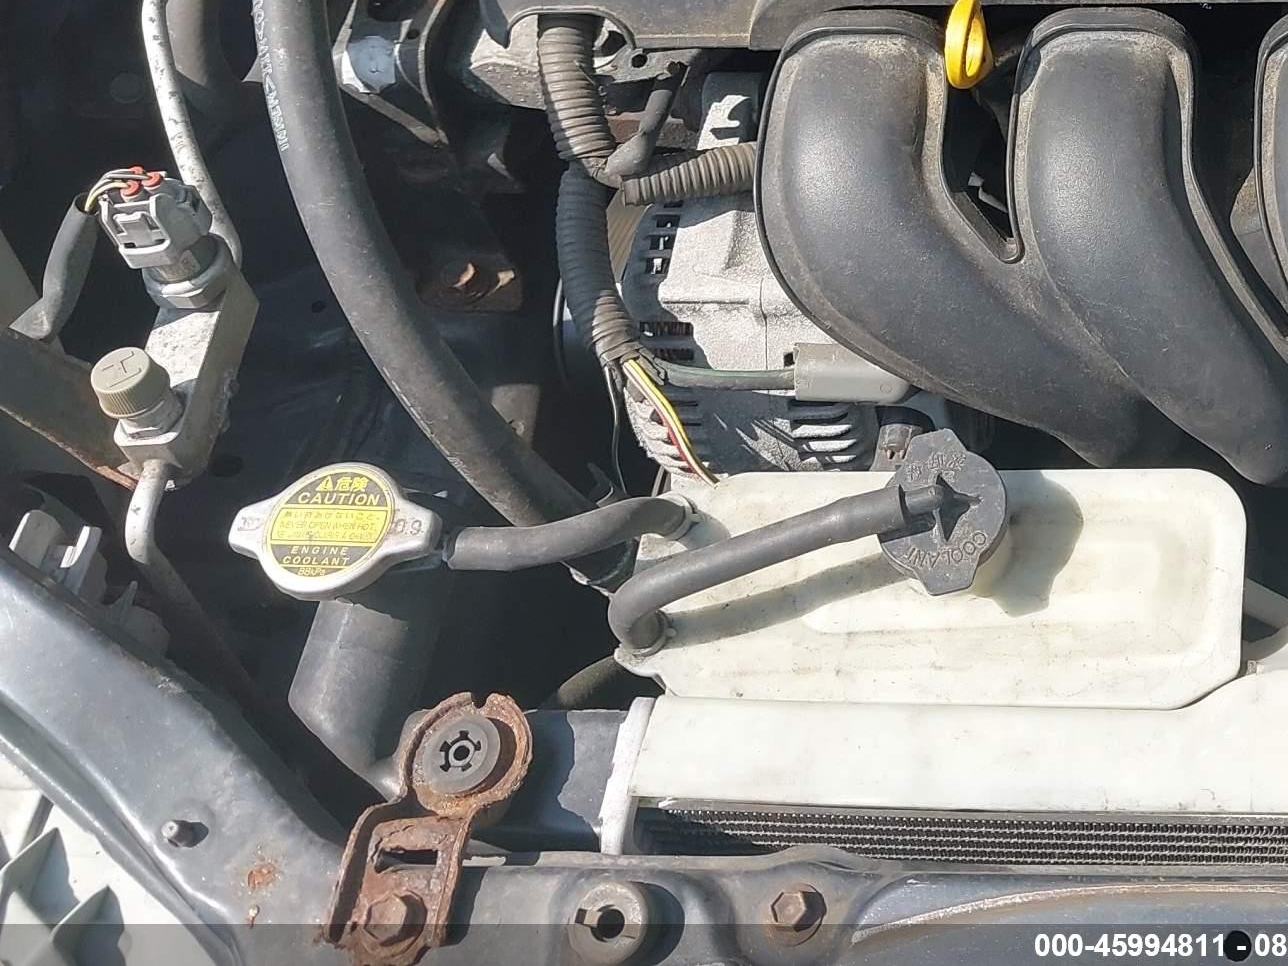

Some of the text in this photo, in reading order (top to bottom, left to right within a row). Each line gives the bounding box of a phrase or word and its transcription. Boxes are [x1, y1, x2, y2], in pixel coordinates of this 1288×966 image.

[297, 492, 380, 506] CAUTION
[290, 545, 349, 555] ENGINE
[903, 530, 987, 570] COOLANT
[282, 555, 351, 565] COOLANT
